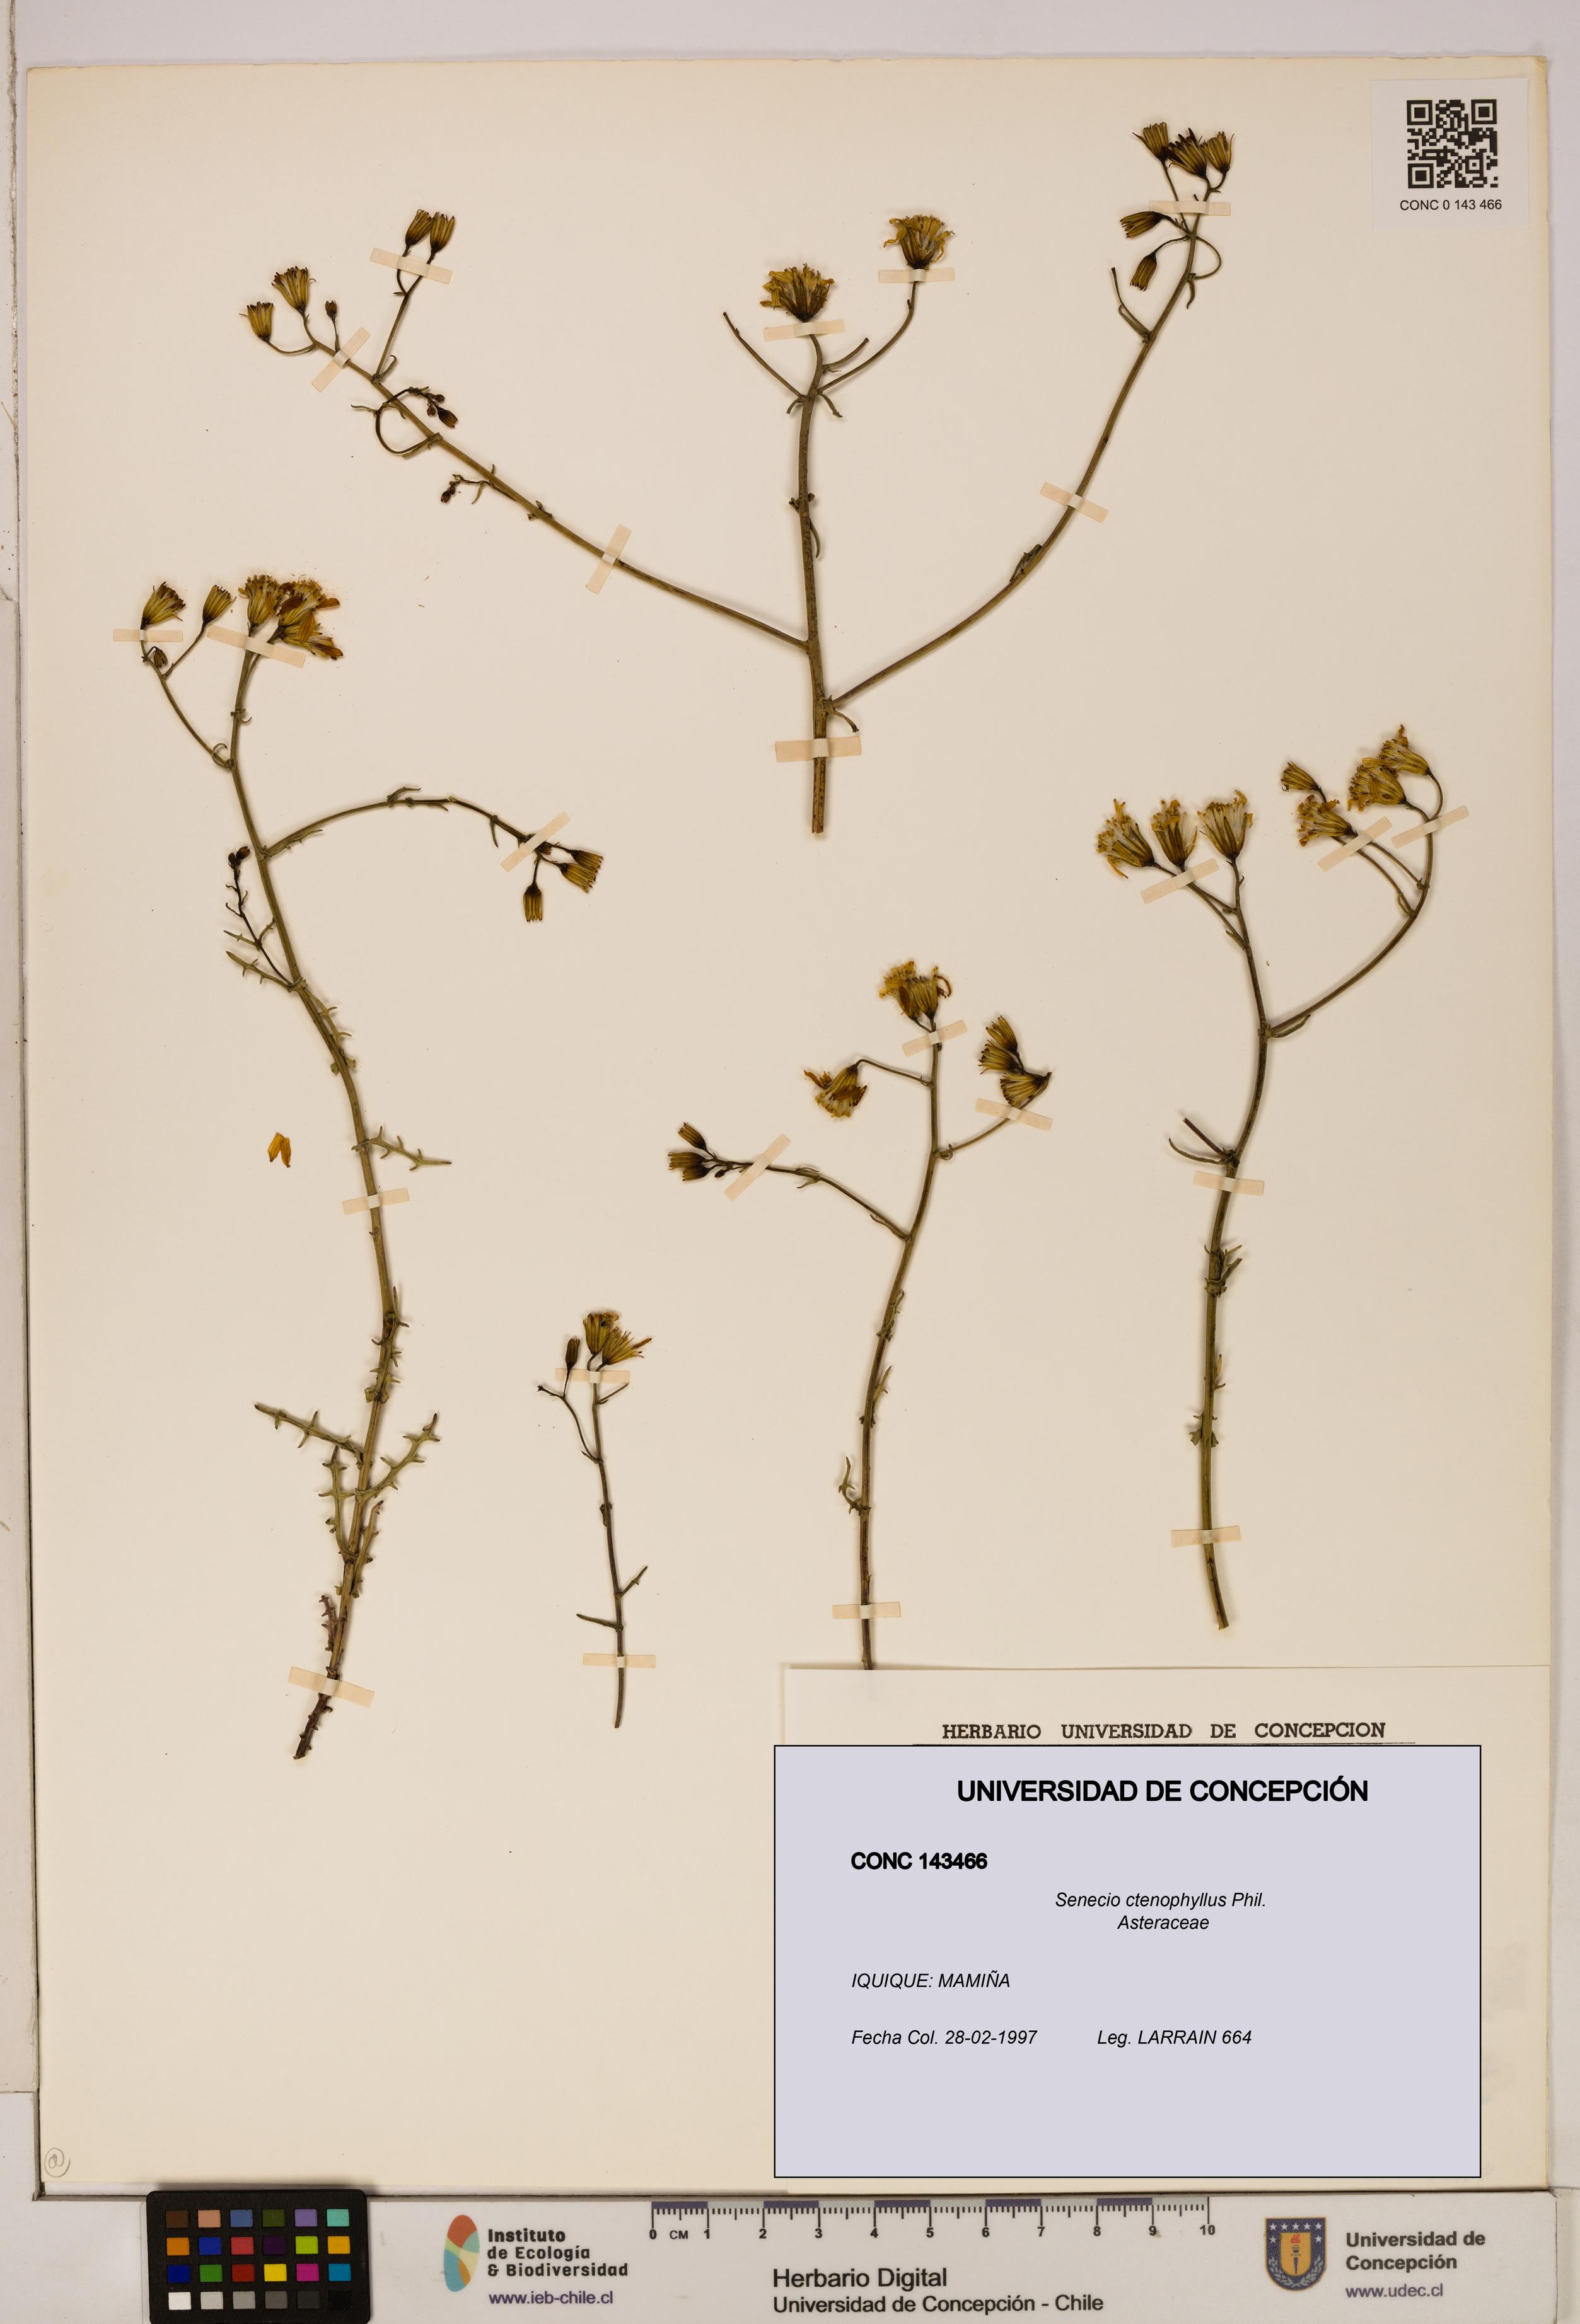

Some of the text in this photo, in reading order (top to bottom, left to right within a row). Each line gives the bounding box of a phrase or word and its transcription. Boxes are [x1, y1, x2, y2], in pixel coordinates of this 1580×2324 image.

[1400, 199, 1502, 211] CONC 0 143 466
[942, 1721, 1386, 1740] HERBARIO UNIVERSIDAD DE CONCEPCION
[488, 2228, 566, 2243] Instituto
[649, 2224, 1216, 2240] 0 CM 1 2 3 4 5 6 7 8 9 10
[1346, 2230, 1486, 2248] Universidad de
[487, 2245, 590, 2261] de Ecología
[487, 2262, 628, 2277] & Biodiversidad
[1345, 2253, 1457, 2274] Concepción
[773, 2267, 947, 2292] Herbario Digital
[489, 2290, 613, 2304] www.ieb-chile.cl
[1345, 2282, 1443, 2298] www.udec.cl
[774, 2296, 886, 2313] Universidad
[892, 2296, 916, 2313] de
[922, 2294, 1035, 2316] Concepción
[1055, 2294, 1104, 2311] Chile
